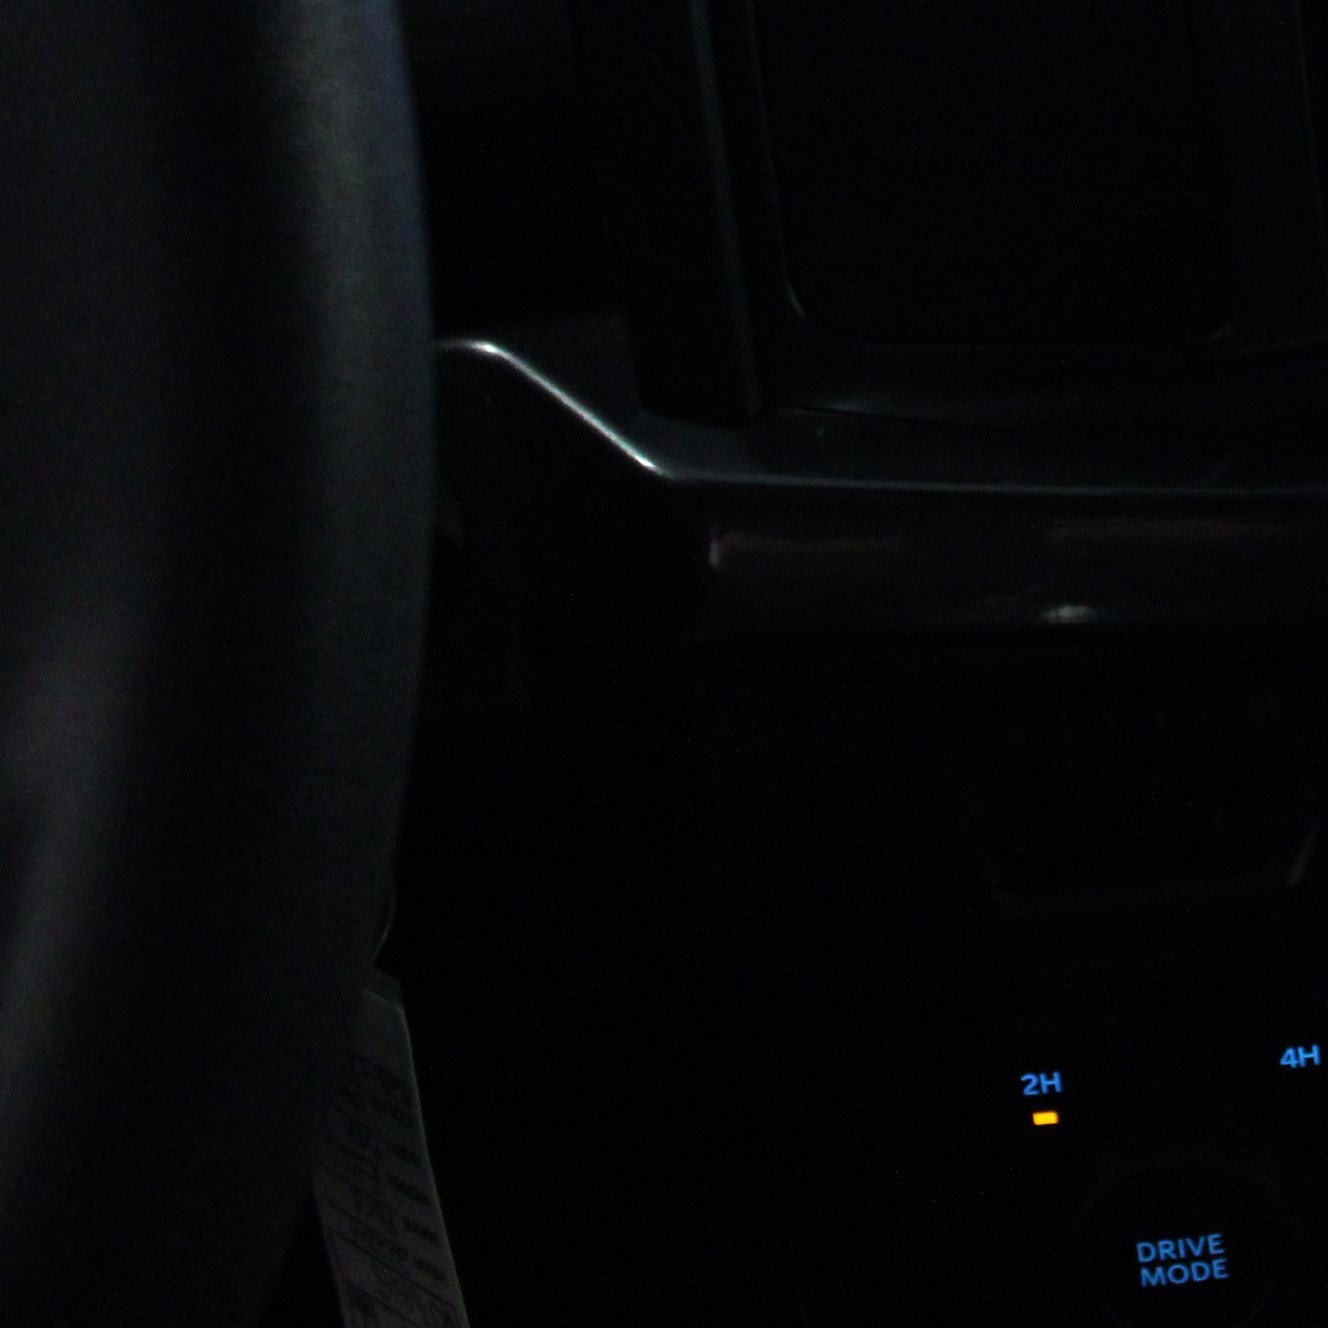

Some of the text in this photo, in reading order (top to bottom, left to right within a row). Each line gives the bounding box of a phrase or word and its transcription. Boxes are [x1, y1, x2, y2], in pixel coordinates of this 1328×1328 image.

[1279, 1044, 1322, 1069] 4H
[1020, 1071, 1063, 1096] 2H
[1136, 1232, 1225, 1263] DRIVE
[1139, 1258, 1230, 1288] MODE
